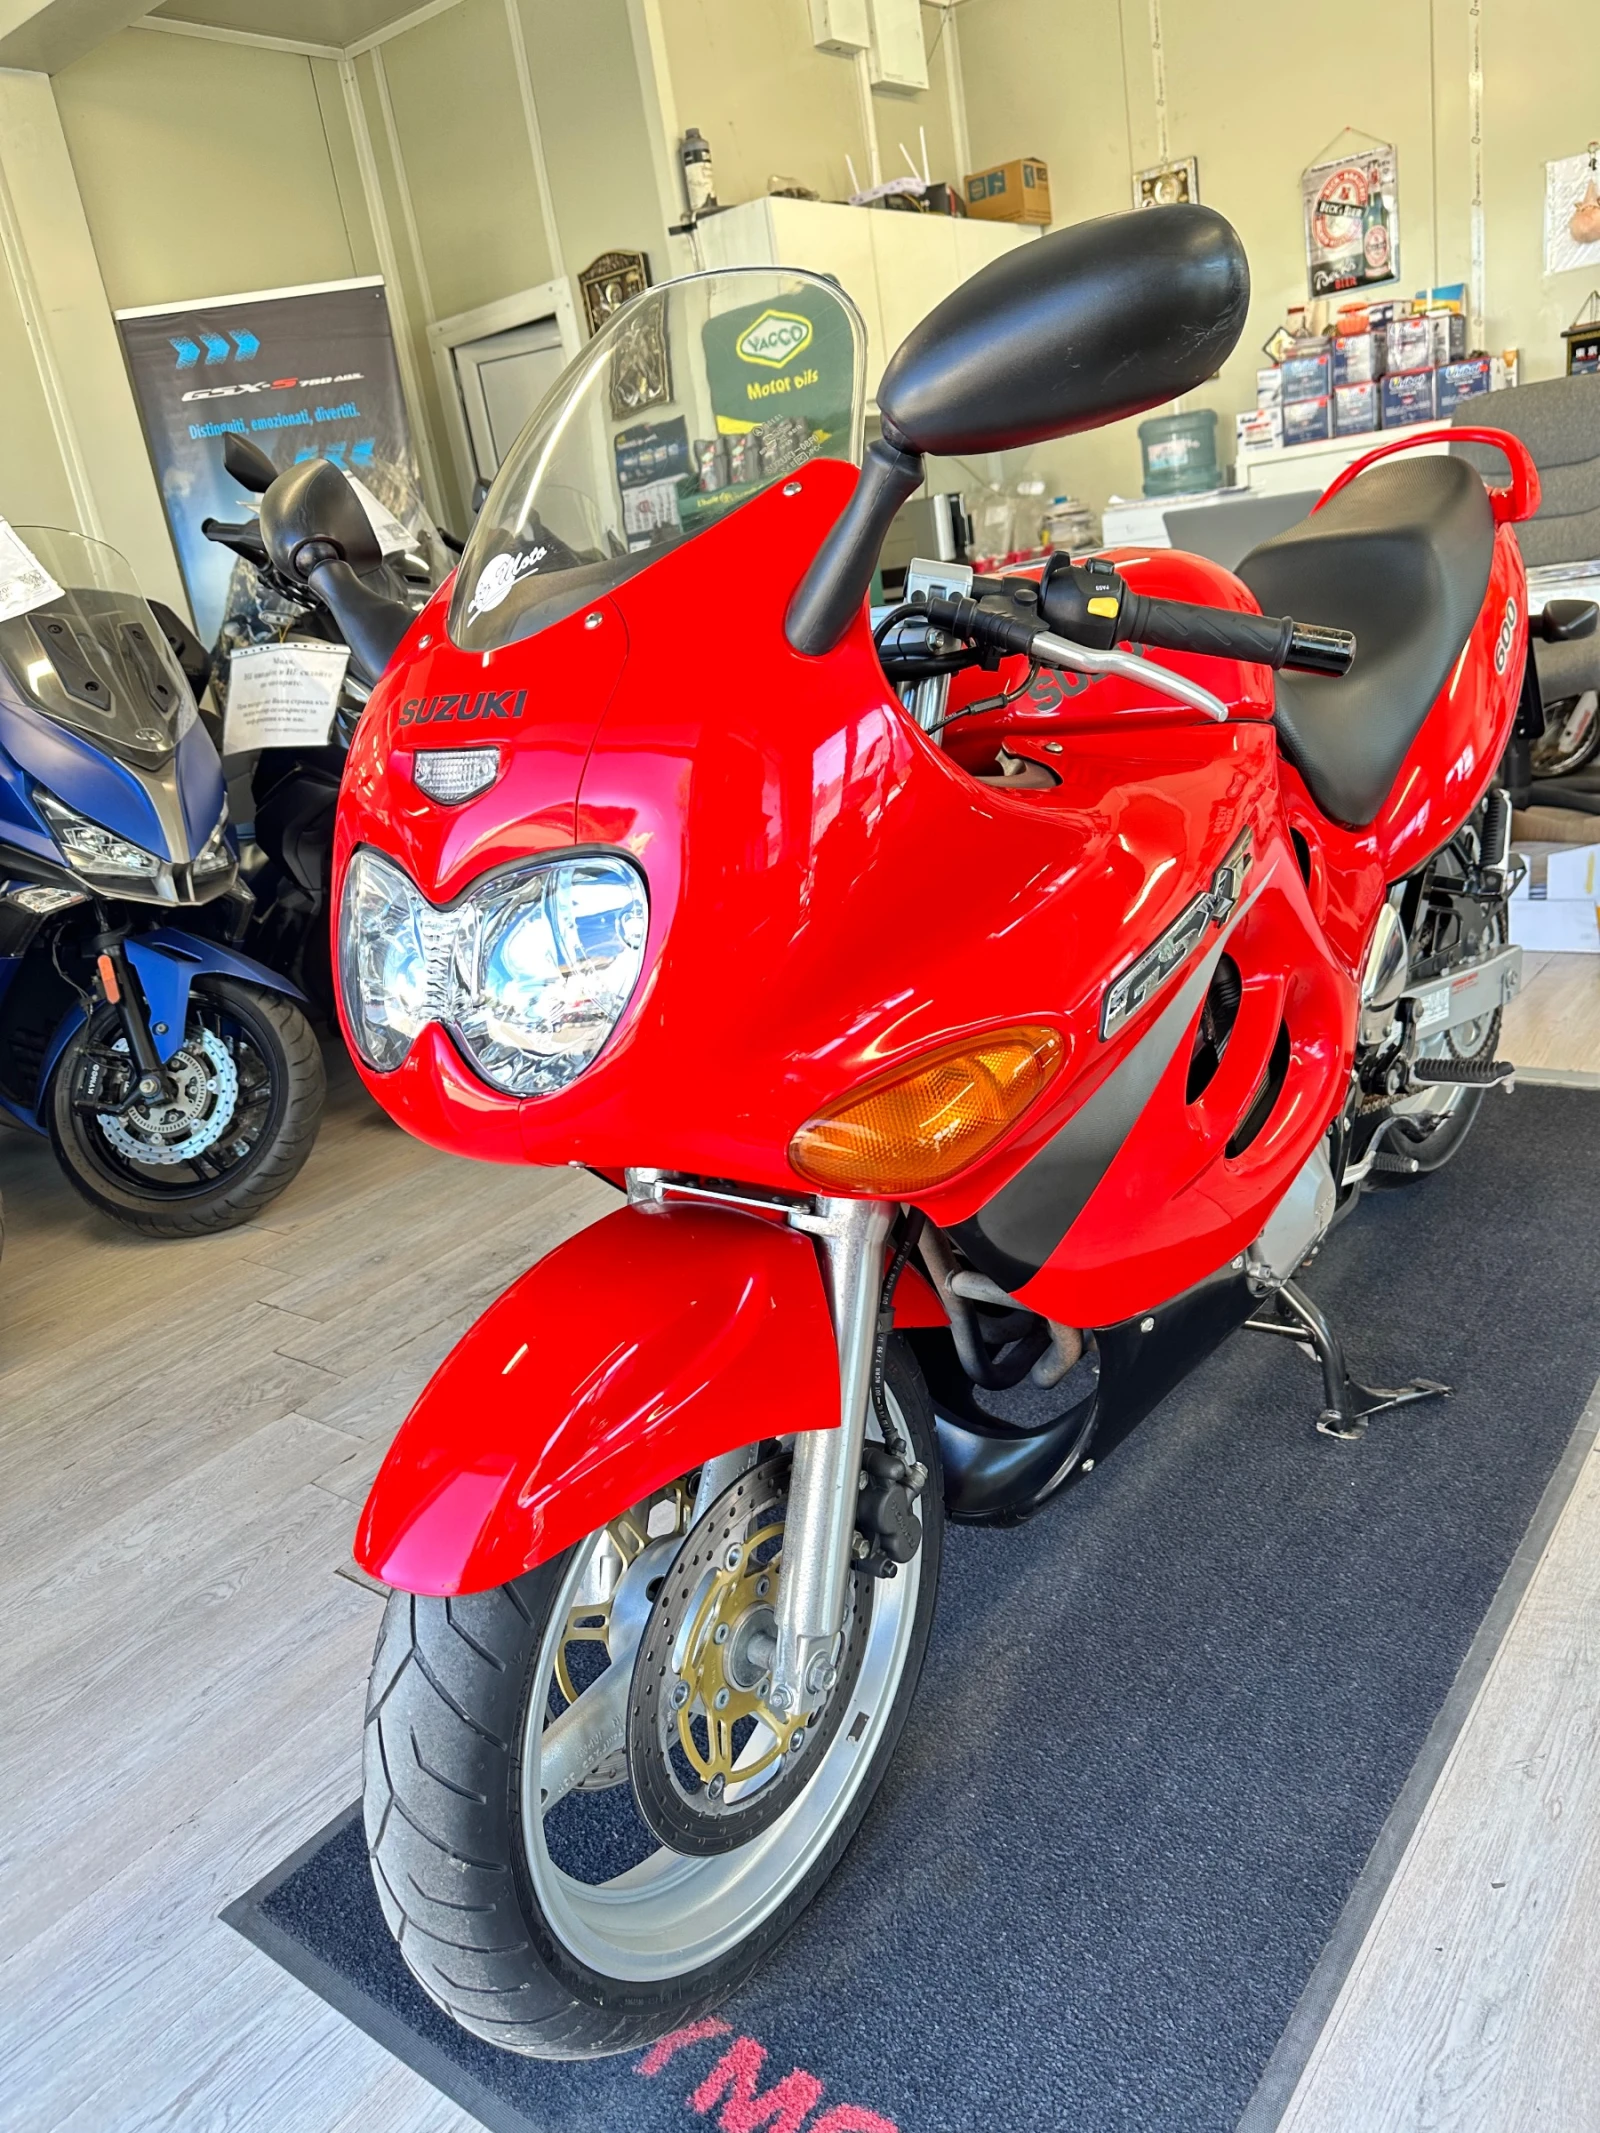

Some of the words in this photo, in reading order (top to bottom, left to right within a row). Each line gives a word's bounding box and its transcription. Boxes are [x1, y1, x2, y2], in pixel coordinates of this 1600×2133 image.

[748, 325, 804, 353] YACCO
[181, 377, 298, 402] GSX-S
[746, 376, 791, 400] Motor
[794, 369, 819, 389] oils
[251, 408, 314, 432] emozionati,
[314, 402, 361, 423] divertiti.
[1494, 596, 1517, 676] 600
[398, 690, 529, 727] SUZUKI
[87, 1063, 100, 1095] KYMCO
